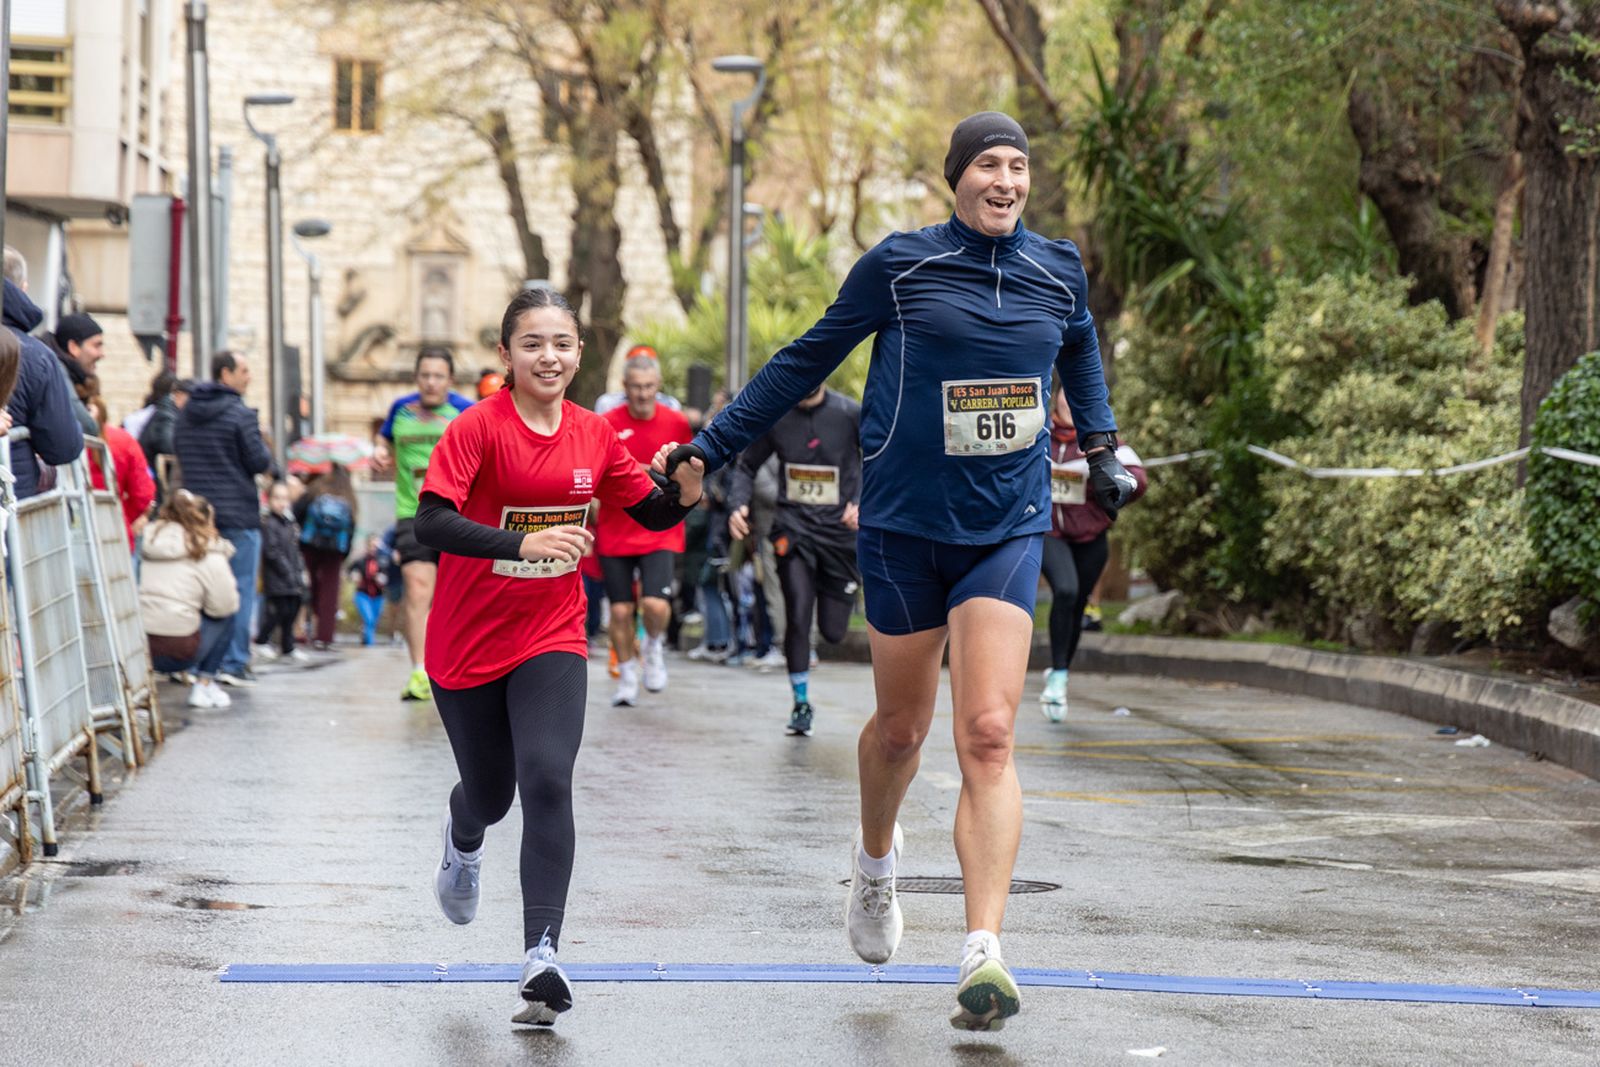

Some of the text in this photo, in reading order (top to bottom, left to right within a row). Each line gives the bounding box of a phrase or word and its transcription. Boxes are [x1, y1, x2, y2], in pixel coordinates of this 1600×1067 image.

[954, 385, 1032, 397] IES San Juan Bosco
[951, 397, 1035, 410] V CARRERA POPULAR
[977, 412, 1016, 440] 616
[799, 483, 823, 495] 573
[512, 512, 582, 523] IES San Juan Bosco
